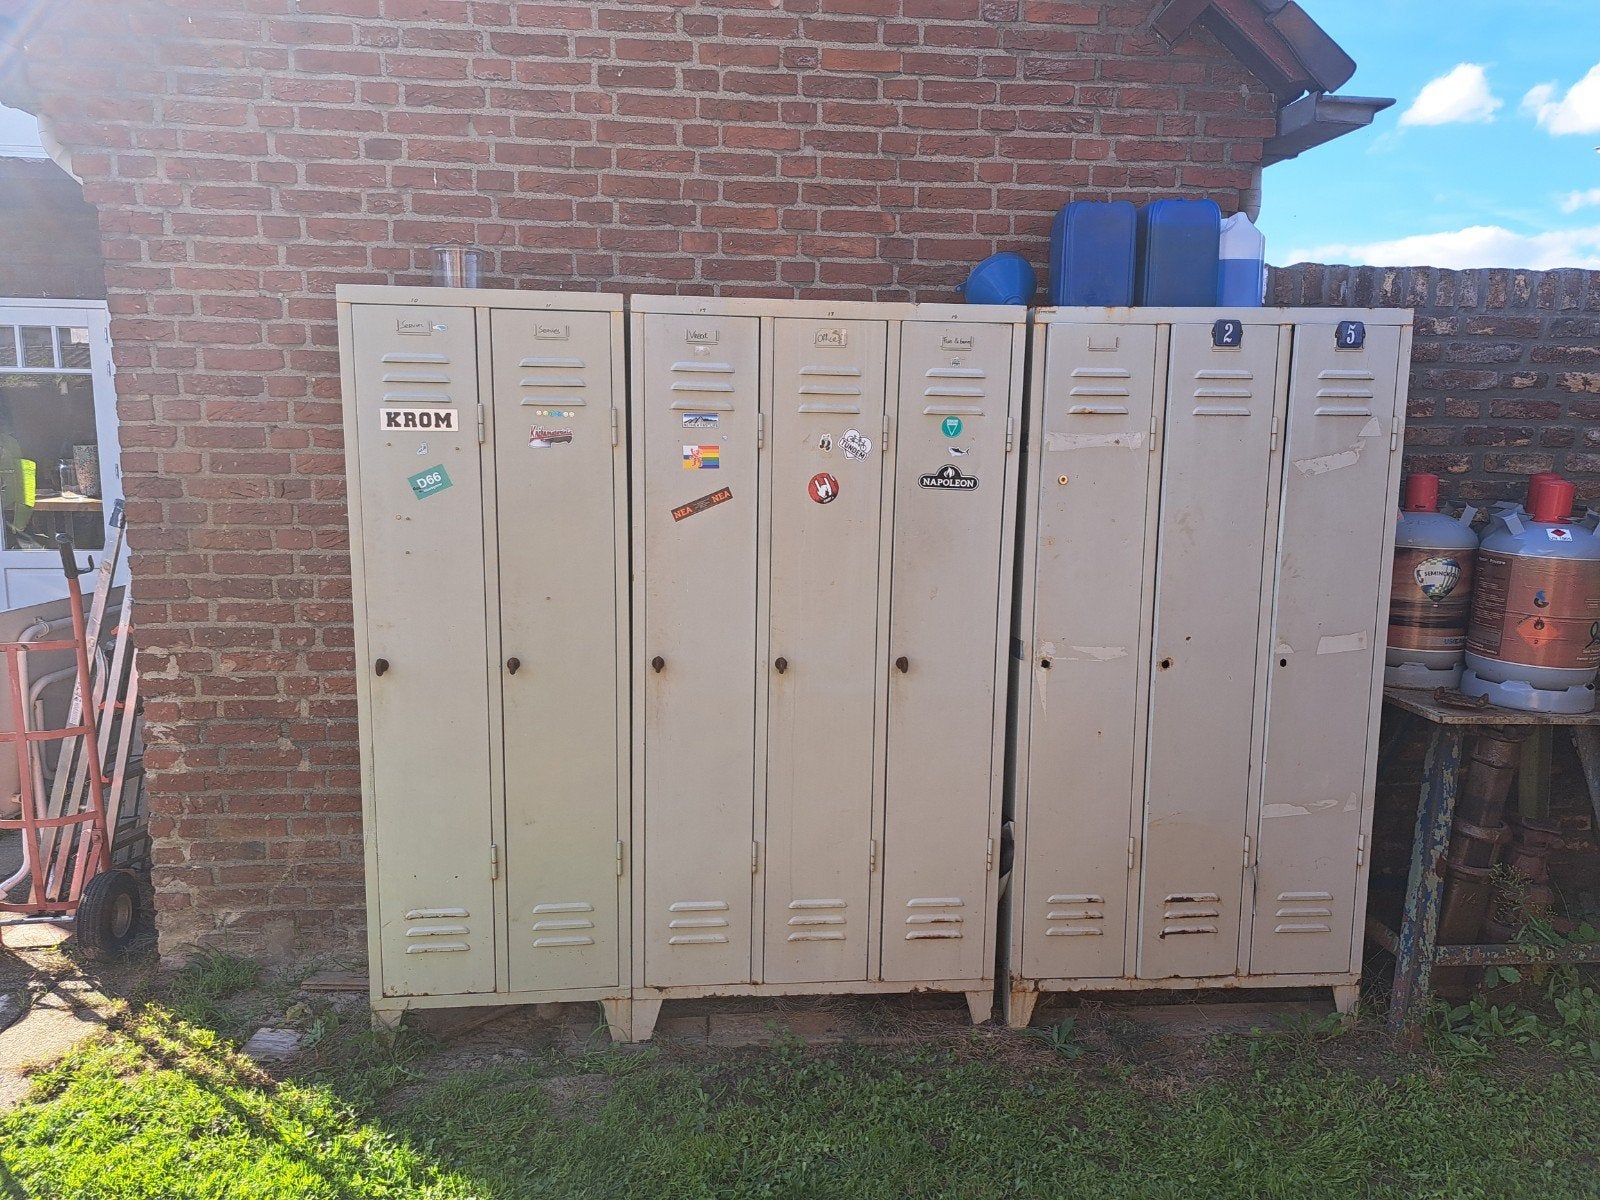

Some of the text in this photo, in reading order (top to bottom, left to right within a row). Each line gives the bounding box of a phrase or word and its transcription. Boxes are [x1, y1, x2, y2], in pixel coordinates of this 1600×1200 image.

[1223, 323, 1234, 343] 2
[1347, 324, 1356, 344] 5
[385, 411, 453, 429] KROM
[416, 472, 442, 488] D66
[923, 477, 975, 488] NAPOLEON
[711, 490, 731, 503] NEA
[673, 506, 694, 519] NEA
